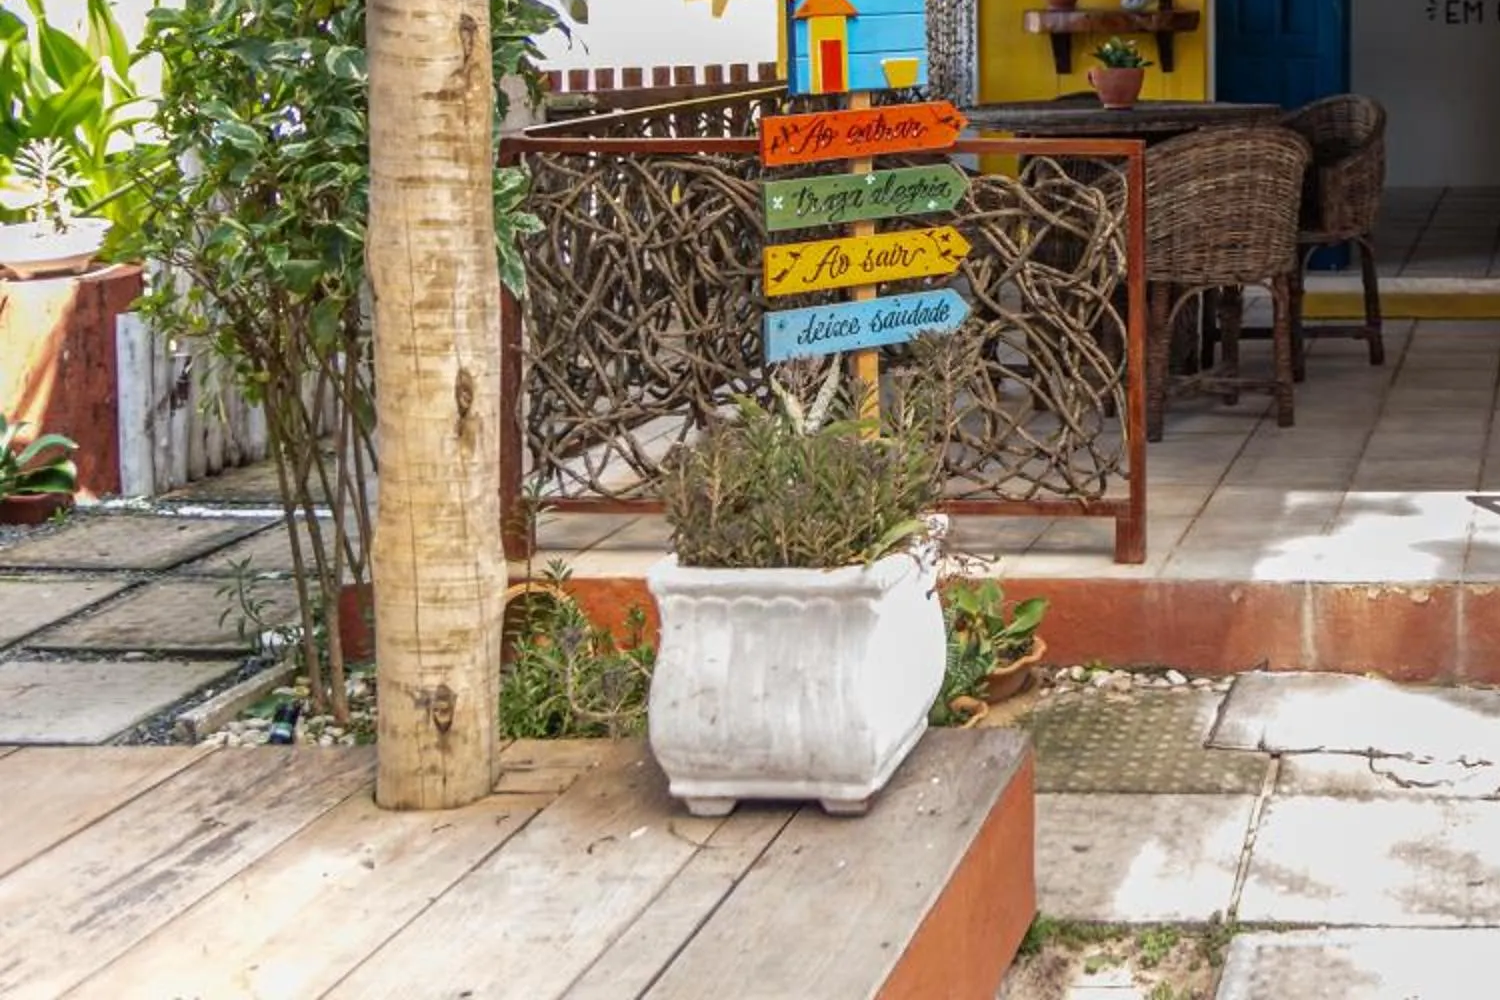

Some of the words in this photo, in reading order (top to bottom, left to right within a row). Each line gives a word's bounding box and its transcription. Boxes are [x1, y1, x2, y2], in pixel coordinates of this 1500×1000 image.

[1445, 0, 1484, 24] EM
[871, 172, 952, 219] alegria
[802, 245, 849, 283] Ao
[858, 243, 926, 273] sair
[797, 313, 861, 345] deixe
[870, 299, 951, 332] saudade
